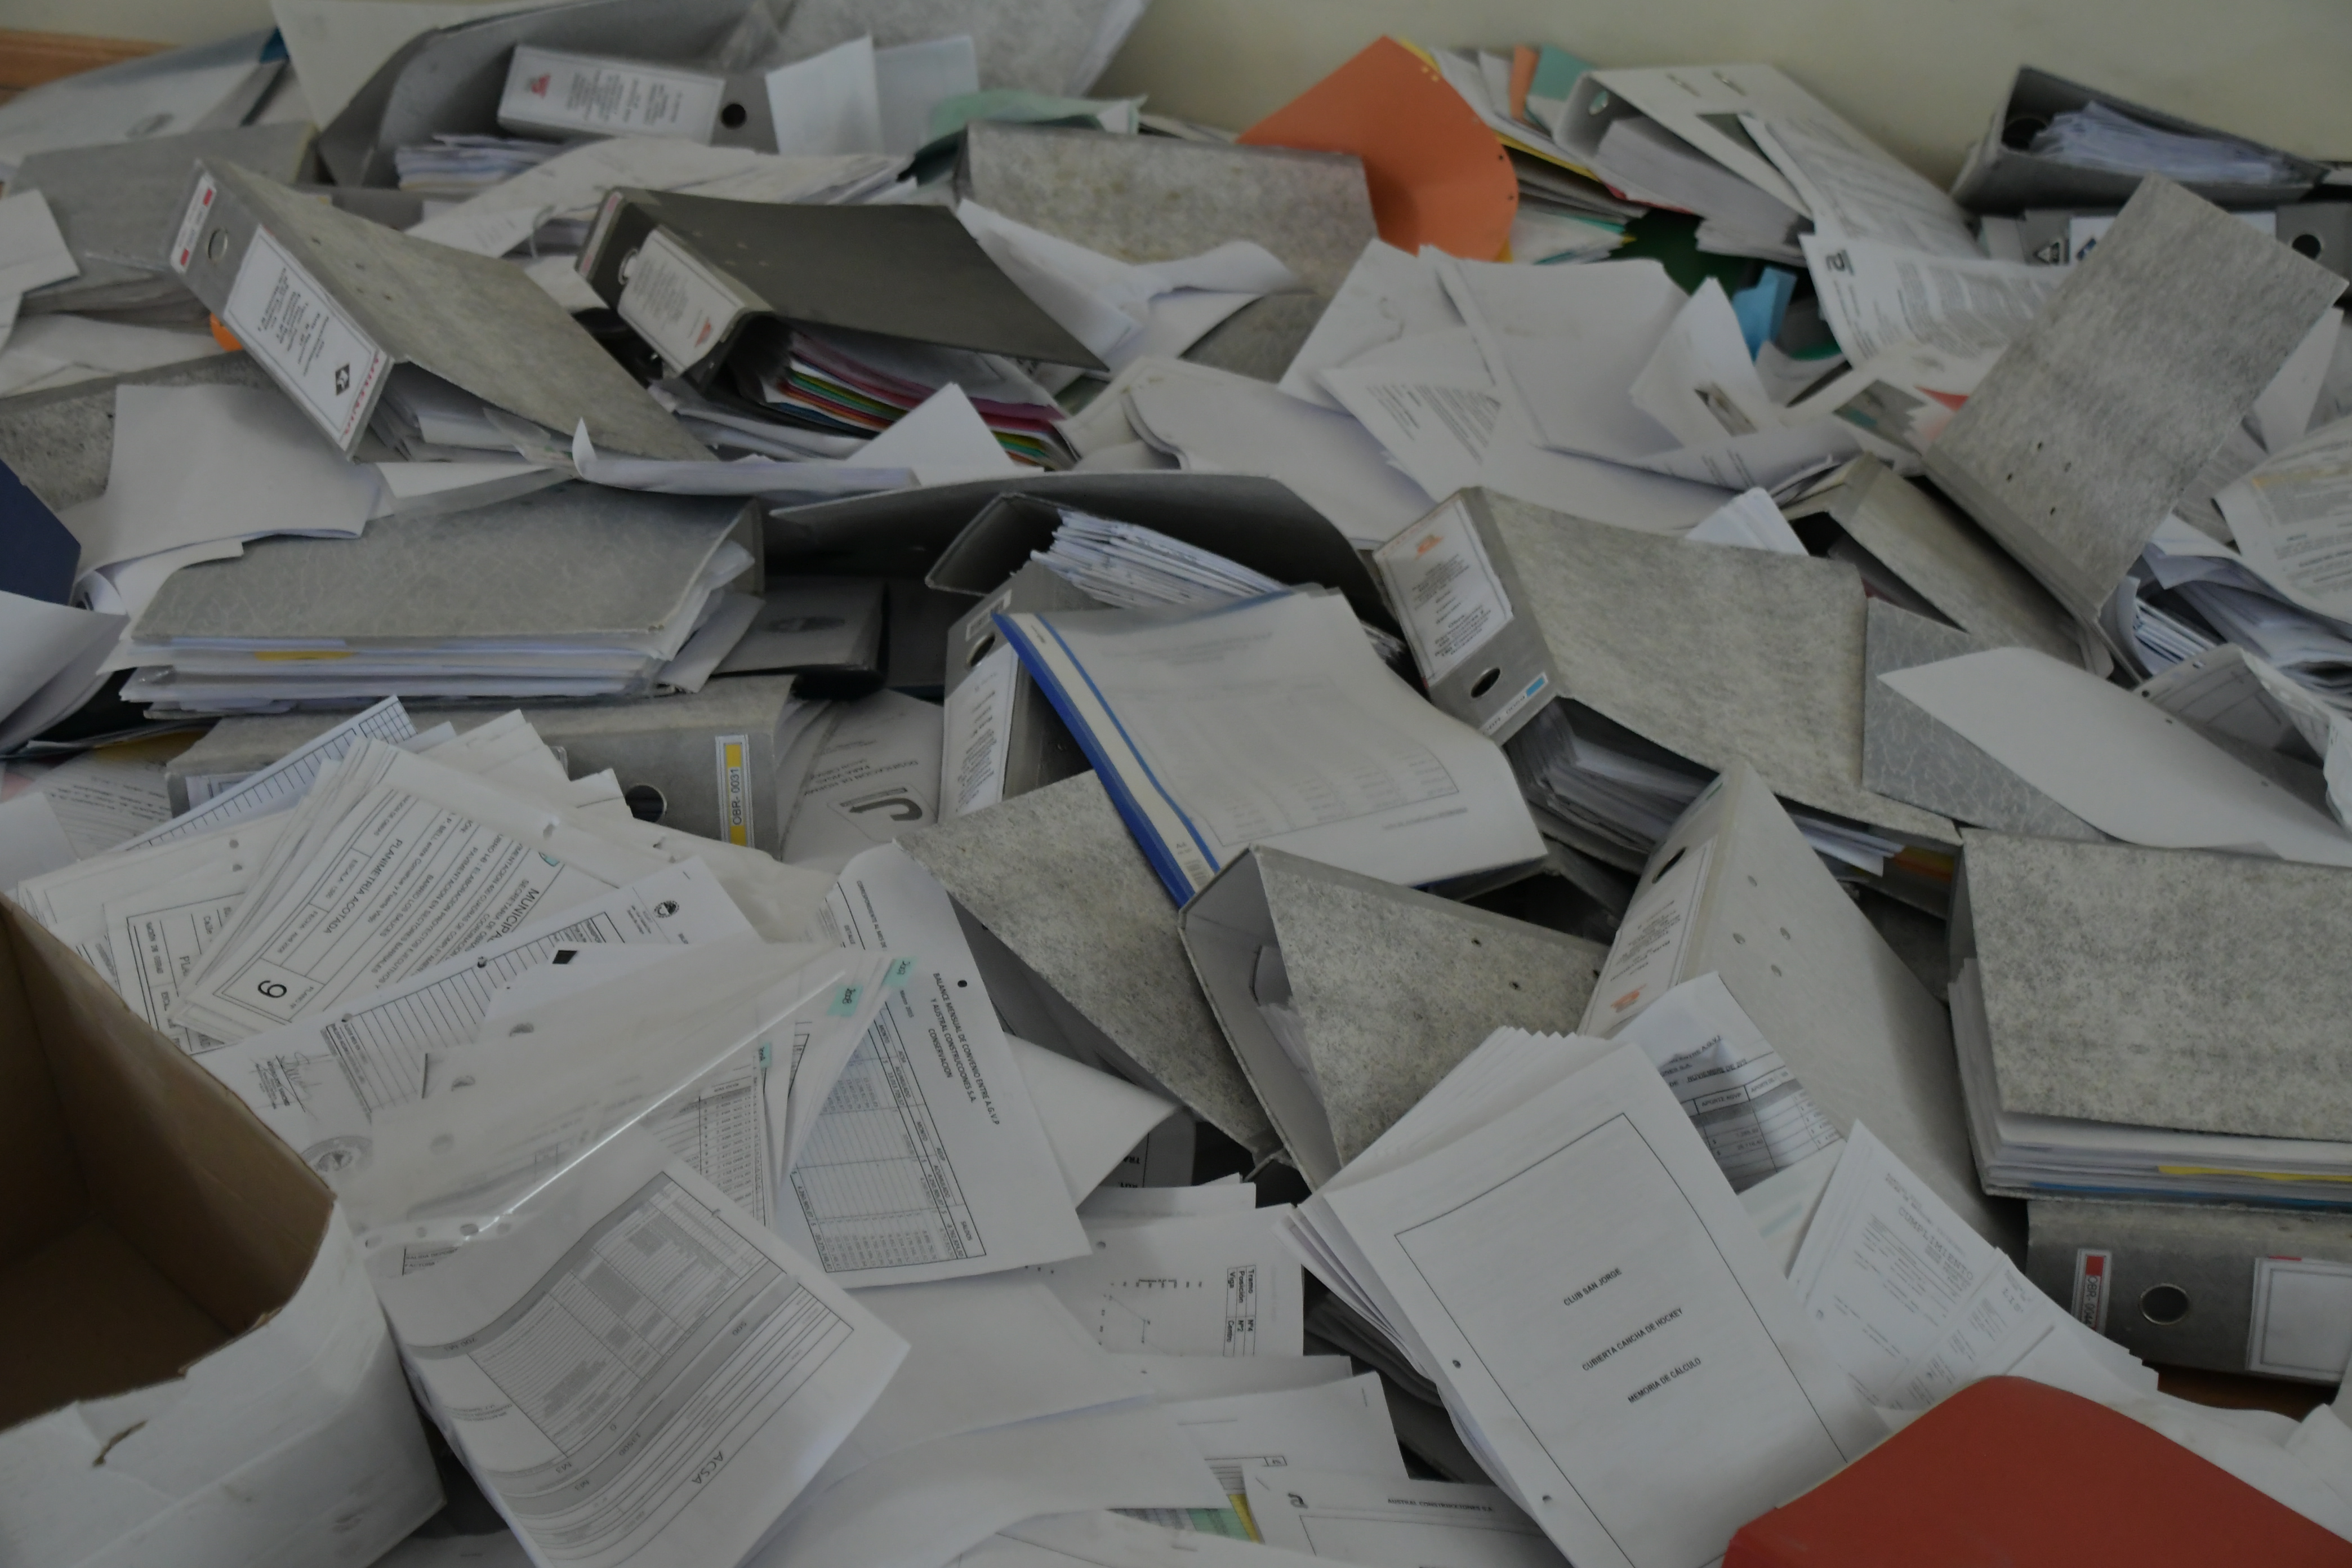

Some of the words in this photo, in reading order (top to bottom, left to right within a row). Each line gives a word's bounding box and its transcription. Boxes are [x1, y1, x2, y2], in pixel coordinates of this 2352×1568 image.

[729, 768, 740, 793] 0031
[730, 796, 742, 825] OBR-
[355, 837, 404, 898] PLANIMETRÍA
[435, 846, 478, 900] PAVIMENTACION
[411, 874, 434, 901] BARRIO
[856, 880, 877, 923] CORRESPONDIENTE
[322, 894, 359, 936] ACOTADA
[400, 898, 415, 913] LOS
[427, 899, 439, 910] EN
[203, 915, 214, 934] Calle
[379, 911, 404, 938] SAUCES
[400, 909, 431, 943] SECTORES
[410, 911, 446, 949] PROYECTOS
[484, 919, 496, 930] DE
[371, 941, 403, 975] BARRIALES
[258, 980, 288, 999] 9
[932, 972, 950, 1002] BALANCE
[945, 1001, 962, 1033] MENSUAL
[927, 1027, 953, 1079] CONSERVACION
[932, 1003, 948, 1032] AUSTRAL
[943, 1032, 972, 1090] CONSTRUCCIONES
[966, 1090, 977, 1103] S.A.
[957, 1033, 966, 1043] DE
[961, 1043, 981, 1079] CONVENIO
[1686, 1066, 1725, 1083] NOVIEMBRE
[975, 1078, 989, 1100] ENTRE
[1701, 1095, 1724, 1107] APORTE
[1725, 1092, 1742, 1101] AGVP
[983, 1099, 1000, 1126] A.G.V.P
[894, 1066, 911, 1099] ACUMULADO
[933, 1164, 951, 1199] ACUMULADO
[897, 1049, 907, 1064] ACSA
[960, 1220, 973, 1241] SALDOS
[1895, 1206, 1976, 1282] CUMPLIMIENTO
[1227, 1272, 1236, 1288] Viga
[1237, 1271, 1246, 1303] Posición
[1562, 1290, 1584, 1307] CLUB
[1582, 1281, 1598, 1295] SAN
[1597, 1267, 1622, 1286] JORGE
[2084, 1276, 2099, 1301] OBR-
[1226, 1320, 1234, 1342] Centro
[1581, 1345, 1618, 1372] CUBIERTA
[1616, 1328, 1646, 1351] CANCHA
[1644, 1322, 1656, 1334] DE
[1654, 1306, 1683, 1328] HOCKEY
[1627, 1379, 1661, 1404] MEMORIA
[1659, 1373, 1671, 1385] DE
[1668, 1354, 1702, 1380] CÁLCULO
[691, 1450, 726, 1487] ACSA
